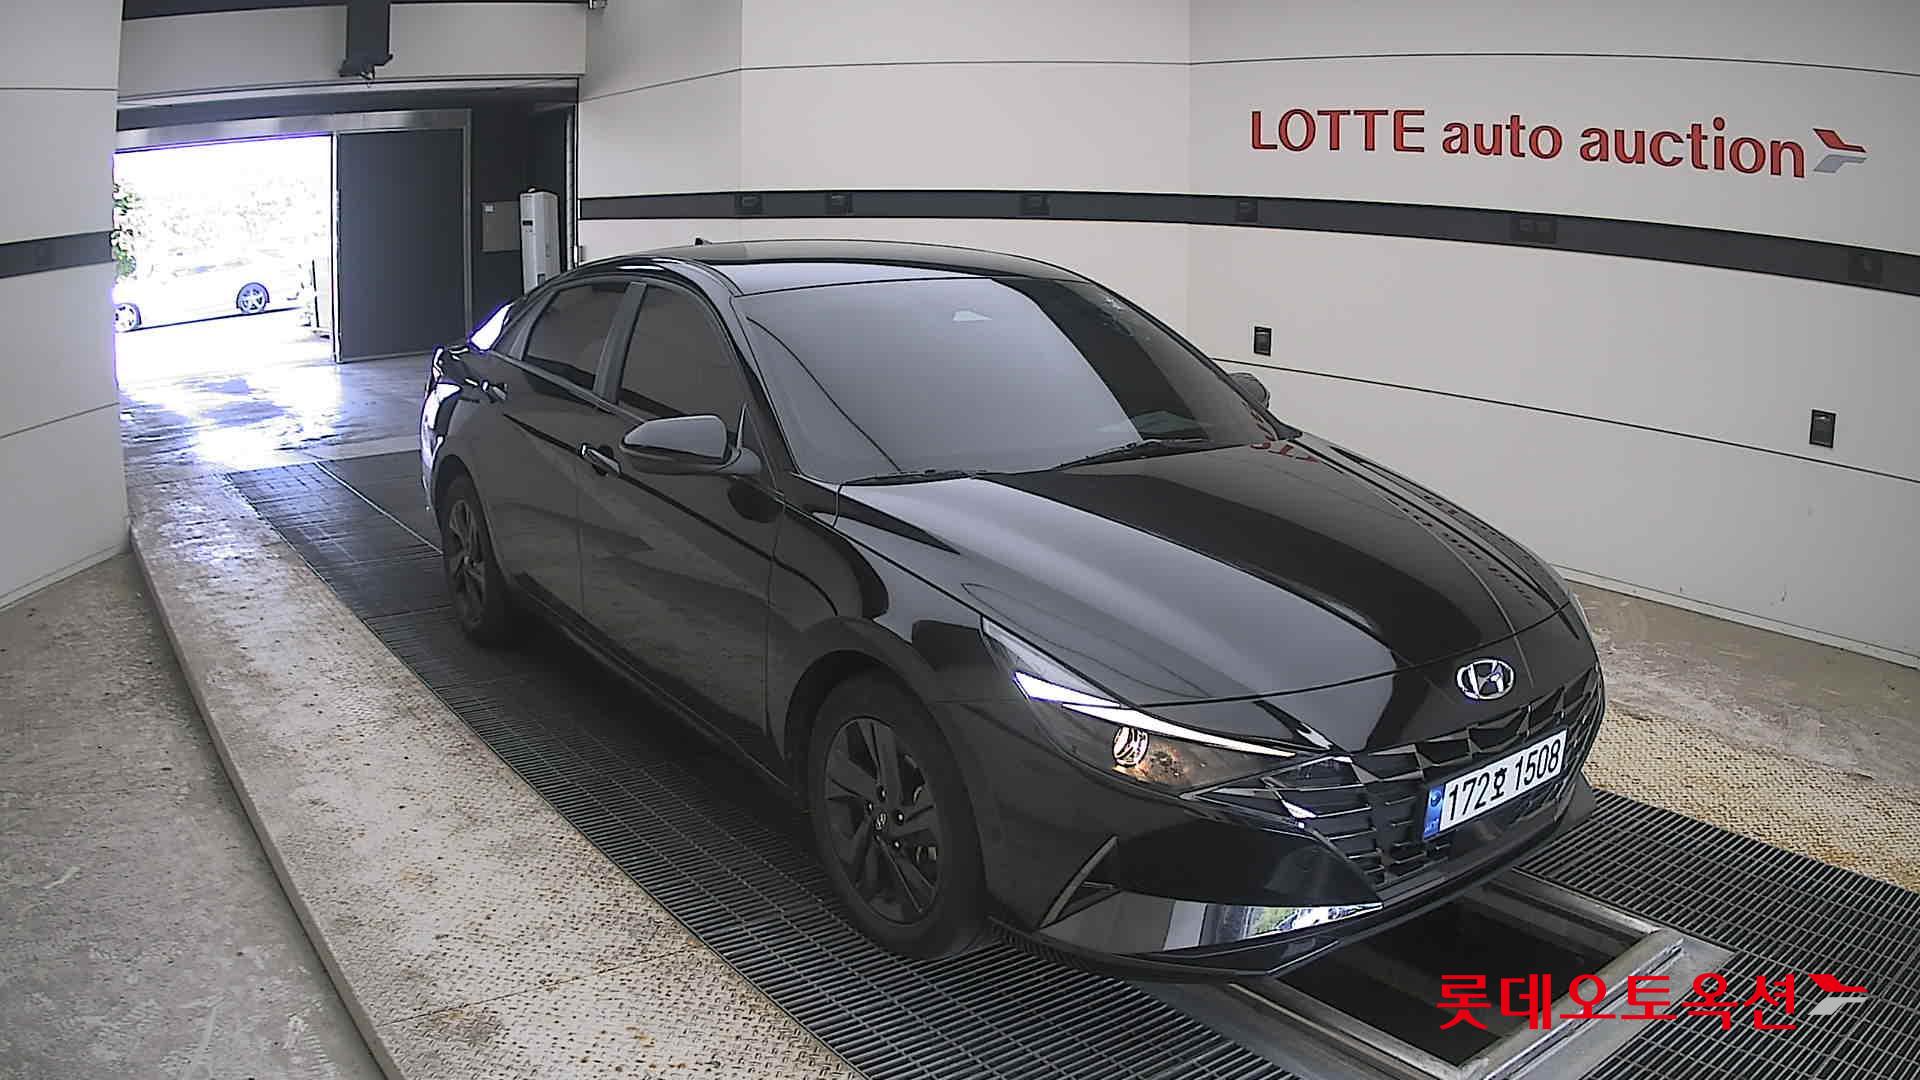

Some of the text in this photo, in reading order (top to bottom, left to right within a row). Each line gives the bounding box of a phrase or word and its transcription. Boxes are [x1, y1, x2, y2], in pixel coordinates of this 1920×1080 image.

[1251, 109, 1806, 179] LOTTE auto auction
[1449, 739, 1561, 821] 172호 1508
